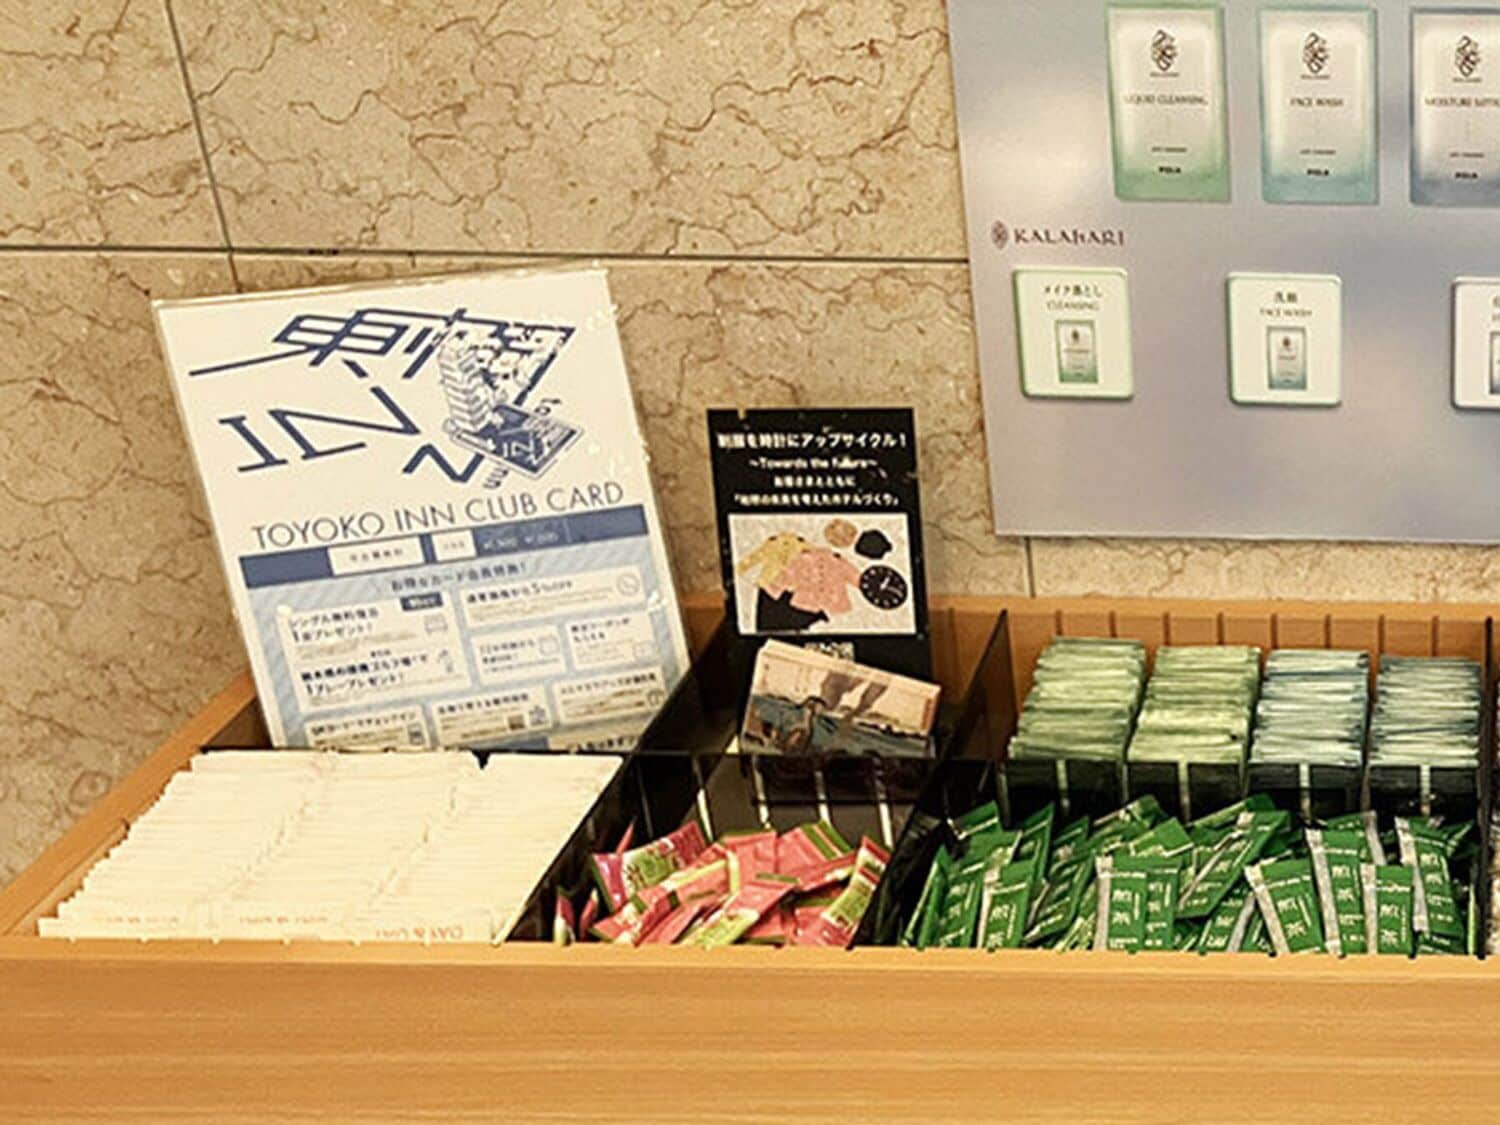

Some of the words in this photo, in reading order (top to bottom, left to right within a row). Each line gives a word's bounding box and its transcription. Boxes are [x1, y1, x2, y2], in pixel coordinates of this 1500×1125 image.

[251, 511, 385, 549] TOYOKO
[394, 503, 456, 532] INN
[465, 491, 538, 521] CLUB
[546, 481, 624, 511] CARD
